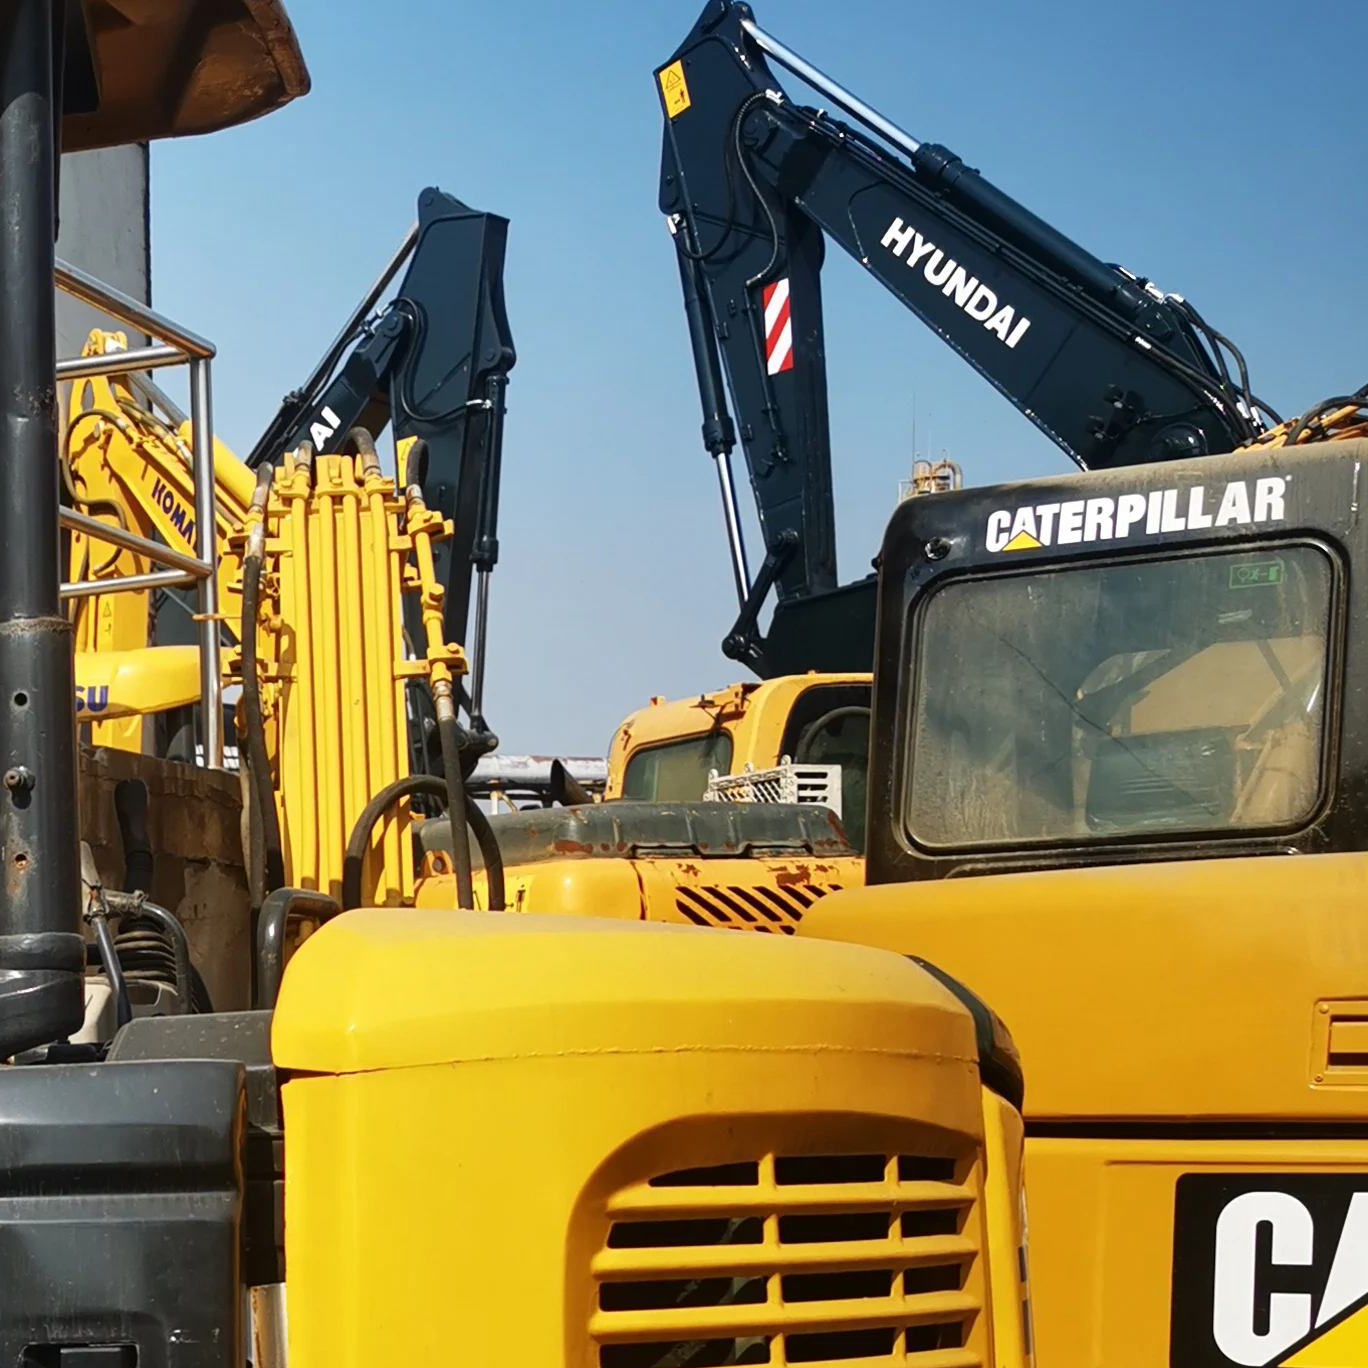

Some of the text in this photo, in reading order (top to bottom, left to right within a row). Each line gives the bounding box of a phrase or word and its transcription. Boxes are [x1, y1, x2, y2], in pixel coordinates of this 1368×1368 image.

[881, 217, 1031, 348] HYUNDAI
[293, 405, 341, 458] AI
[151, 476, 199, 552] KOMA
[985, 476, 1285, 552] CATERPILLAR
